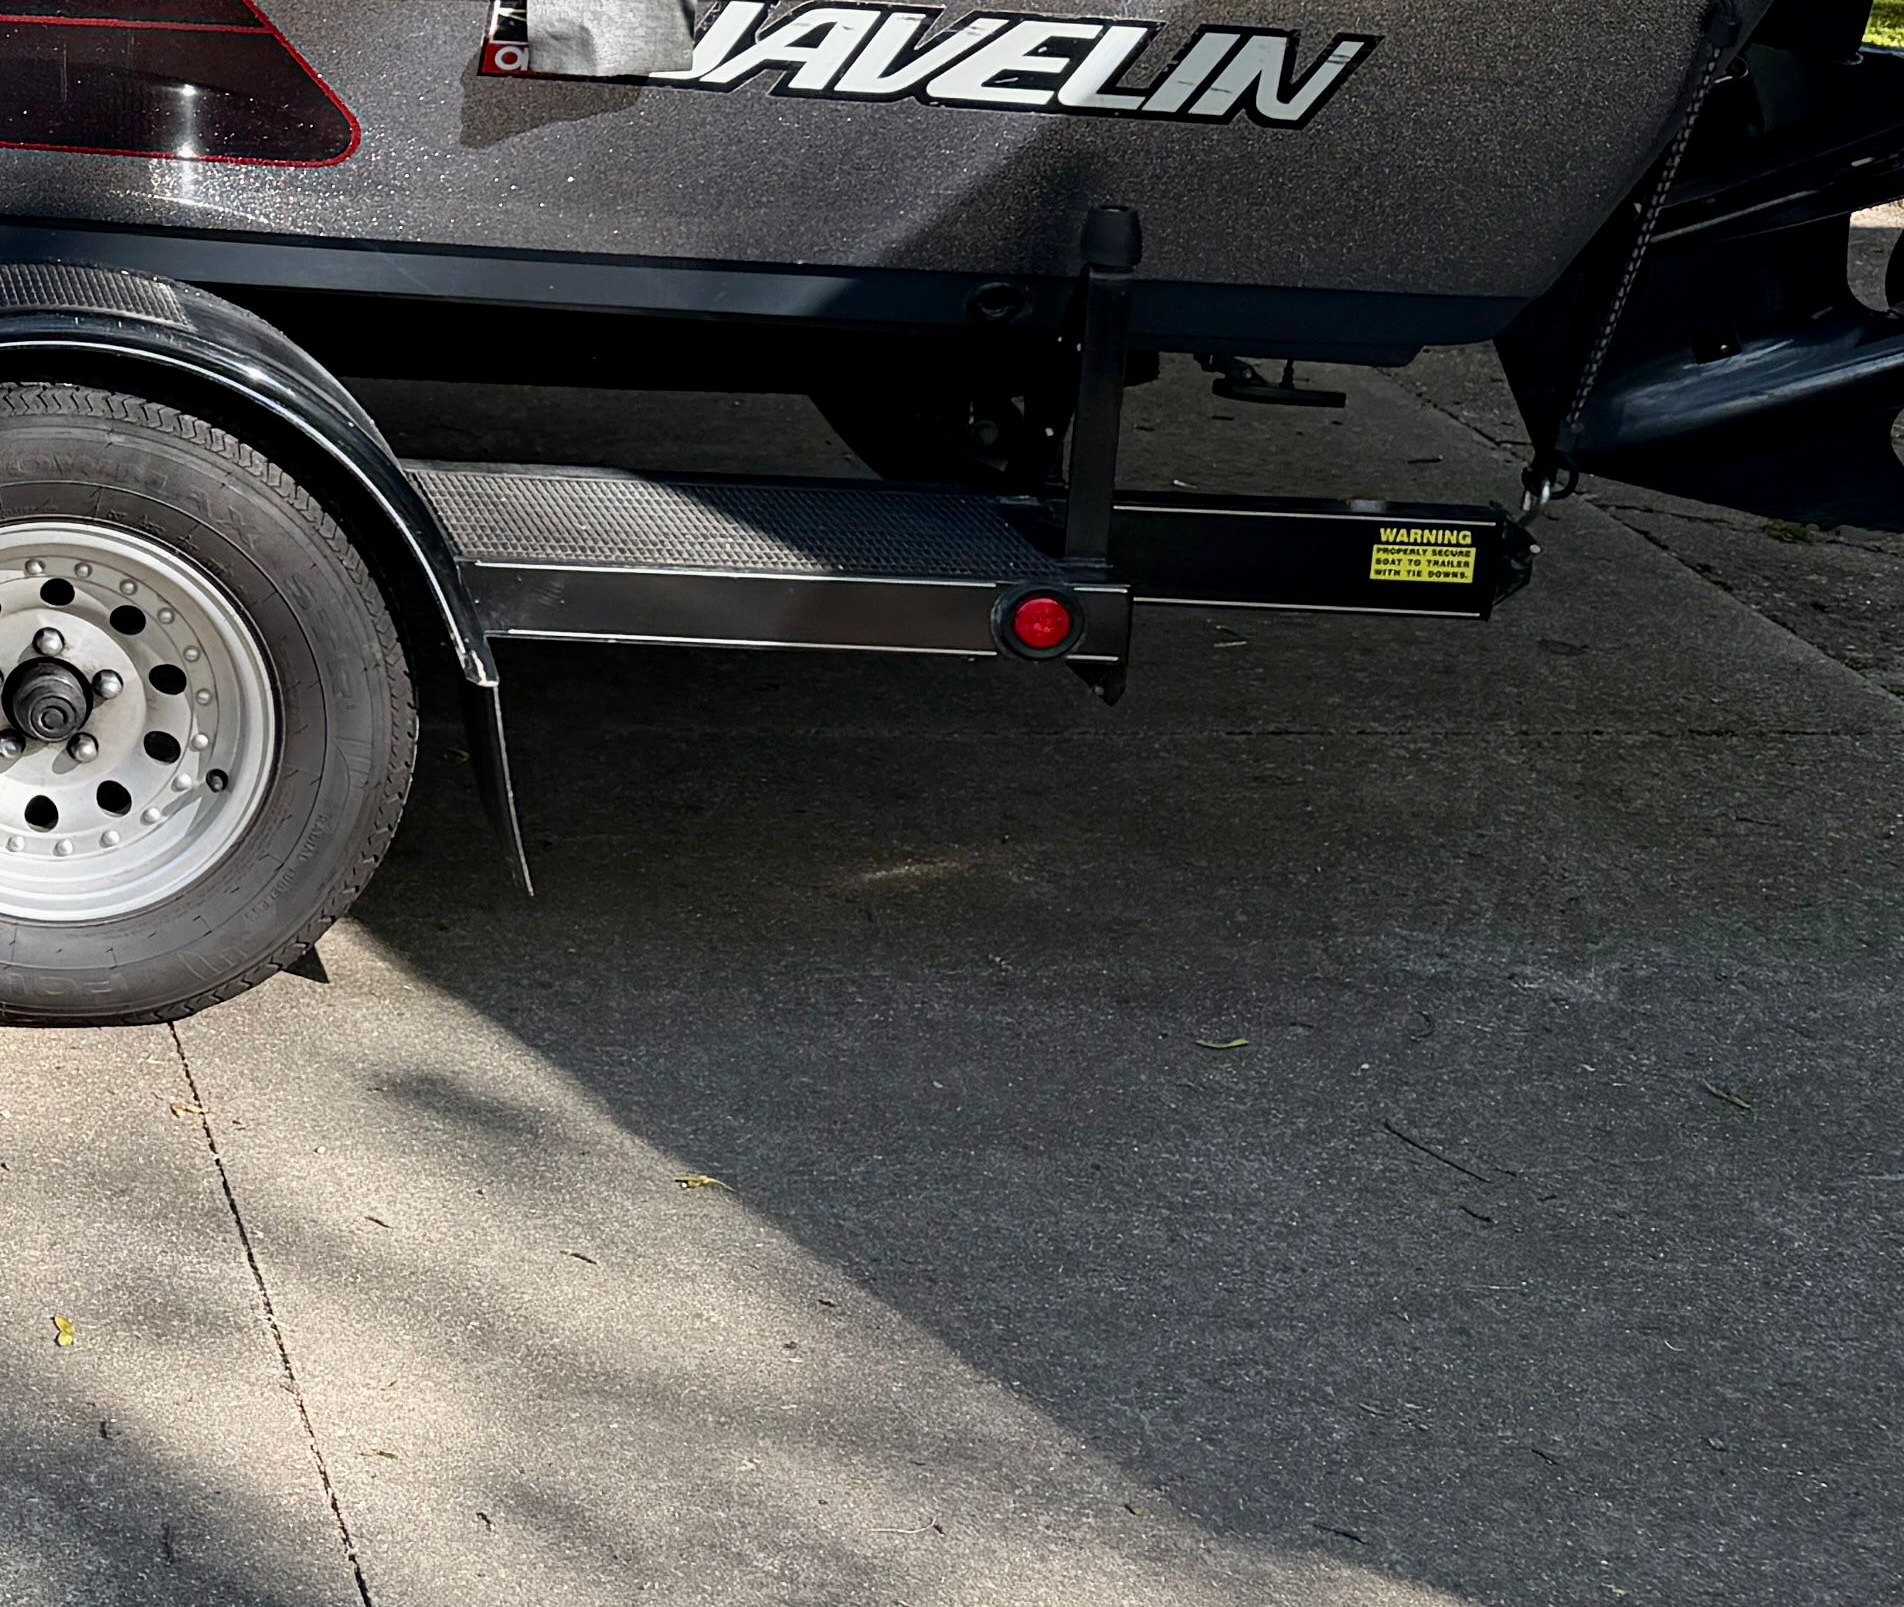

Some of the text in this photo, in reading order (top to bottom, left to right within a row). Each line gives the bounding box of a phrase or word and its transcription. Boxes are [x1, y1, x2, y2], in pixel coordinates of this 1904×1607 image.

[649, 0, 1365, 121] JAVELIN
[1380, 528, 1472, 545] WARNING
[1376, 547, 1471, 558] PROPERLY SECURE
[1375, 558, 1470, 568] BOAT TO TRAILER
[1374, 569, 1401, 577] WITH
[1406, 569, 1422, 577] TIE
